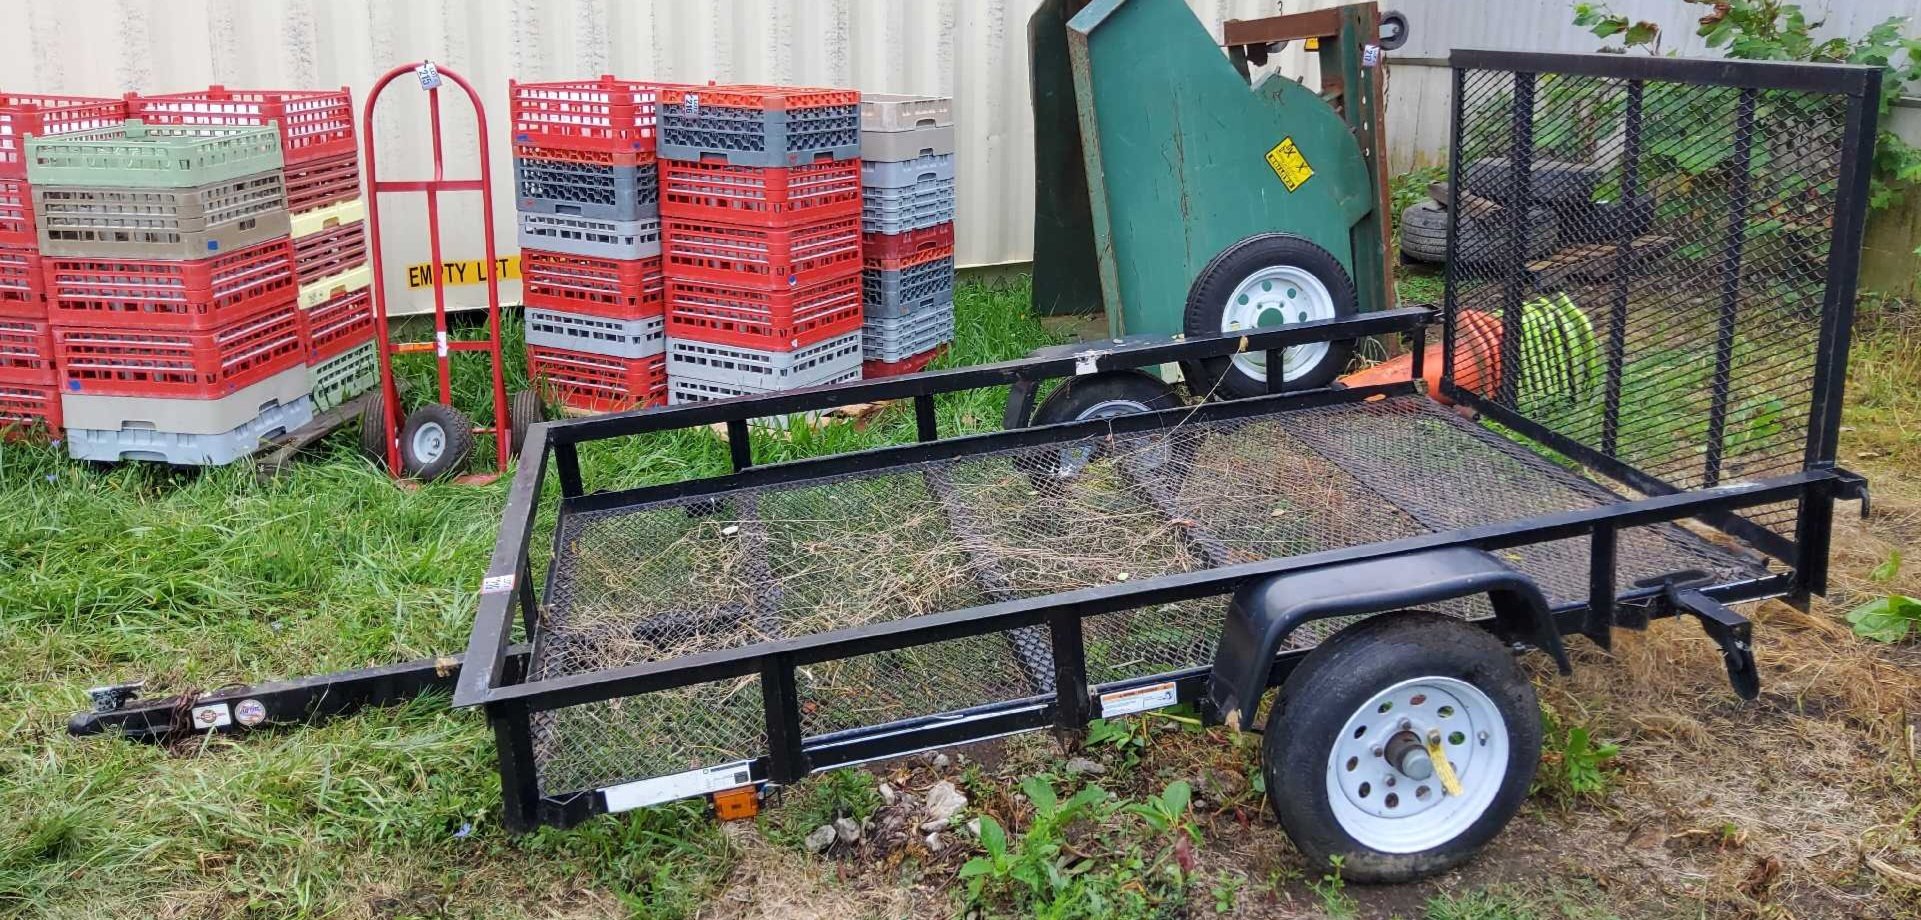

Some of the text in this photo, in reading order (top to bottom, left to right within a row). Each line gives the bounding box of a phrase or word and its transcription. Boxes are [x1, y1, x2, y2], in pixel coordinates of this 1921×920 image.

[420, 69, 431, 86] 215
[1269, 155, 1294, 187] CAUTION
[409, 262, 466, 288] EMTY
[477, 258, 509, 282] LT
